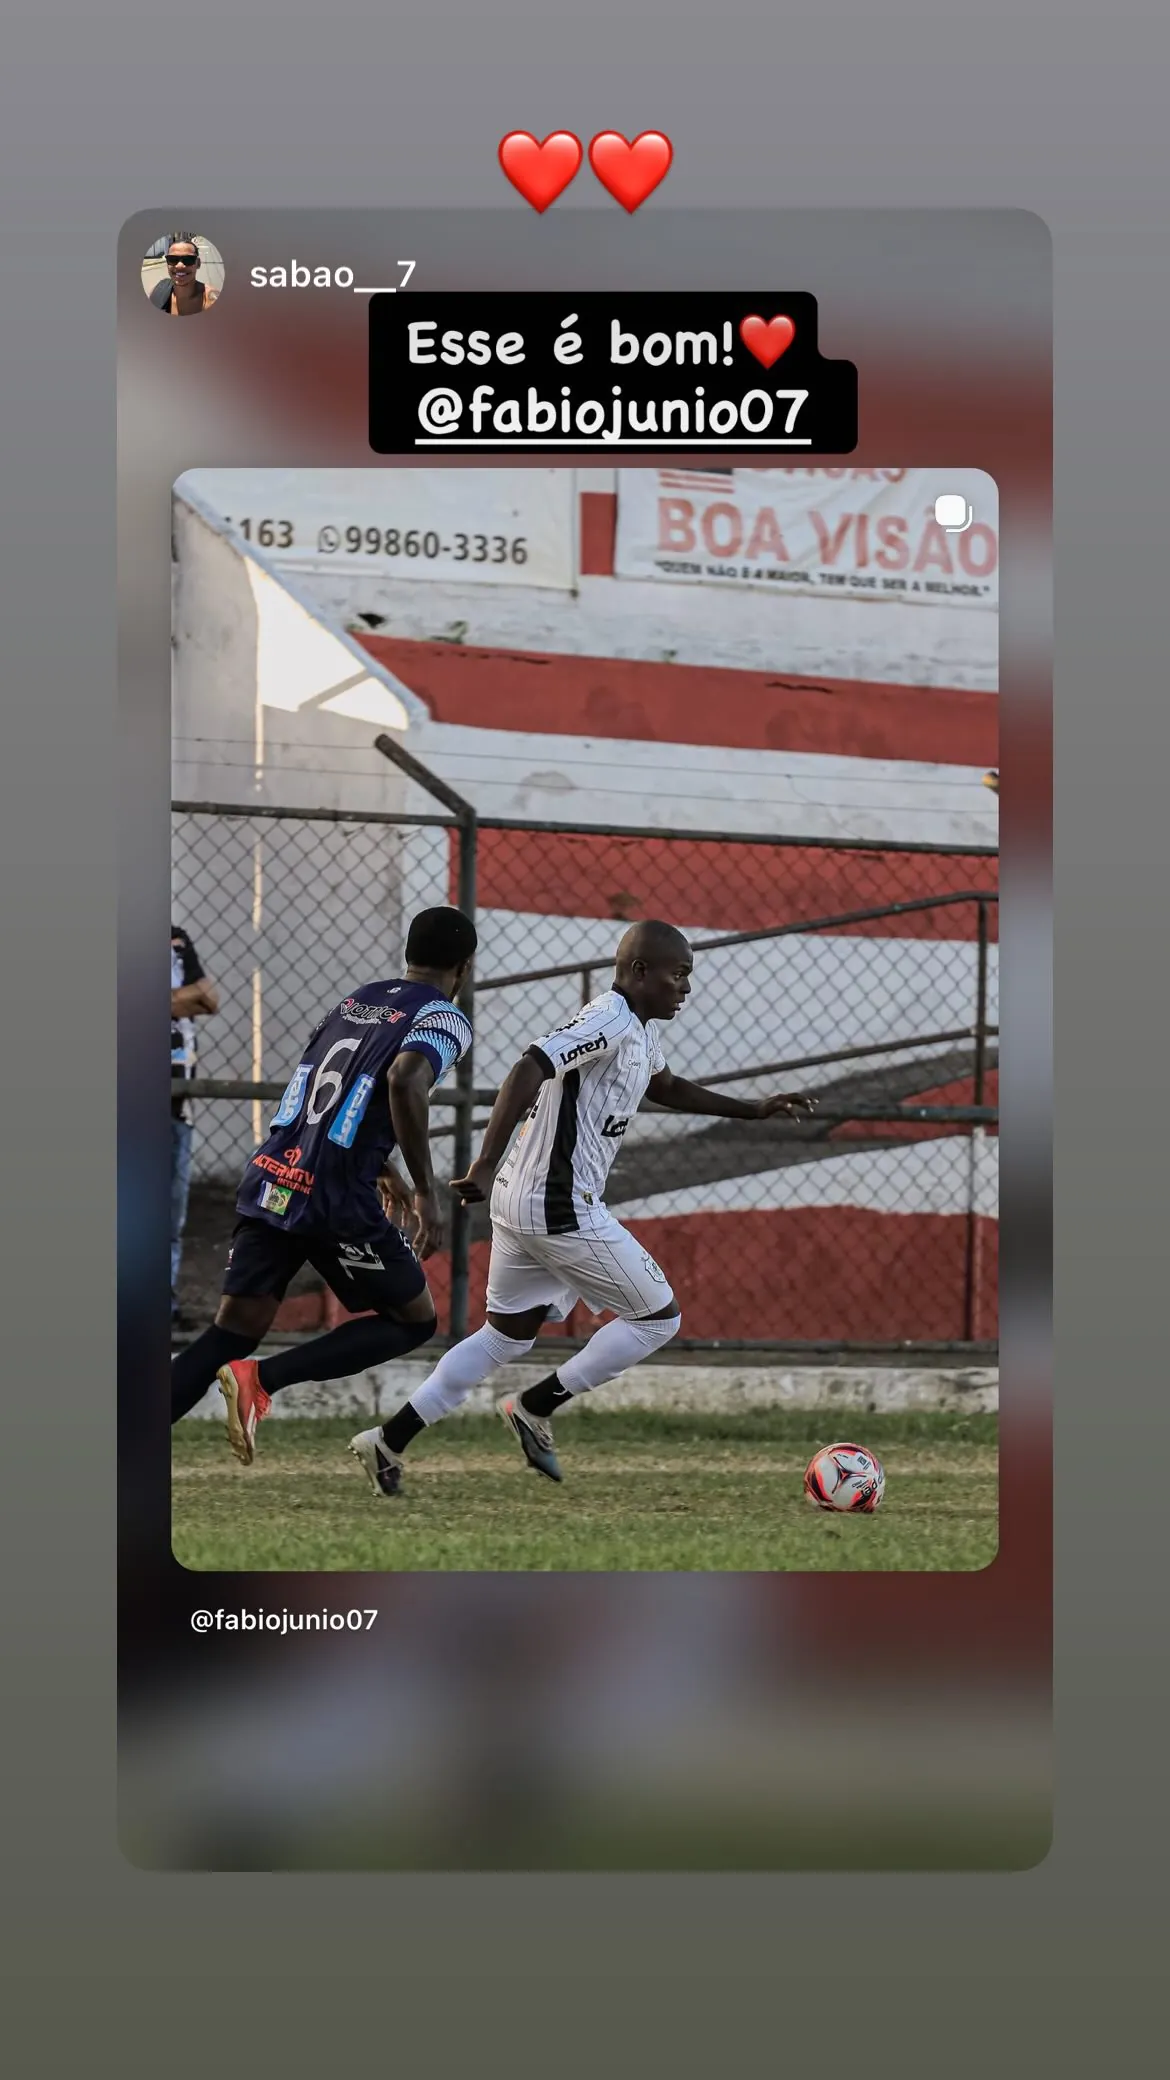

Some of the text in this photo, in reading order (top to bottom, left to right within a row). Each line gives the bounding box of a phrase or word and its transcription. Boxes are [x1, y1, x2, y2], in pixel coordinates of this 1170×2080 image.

[224, 516, 528, 565] 163 99860-3336
[656, 496, 998, 578] BOA VISÃO
[306, 1037, 362, 1125] 6
[560, 1031, 608, 1066] Loterj
